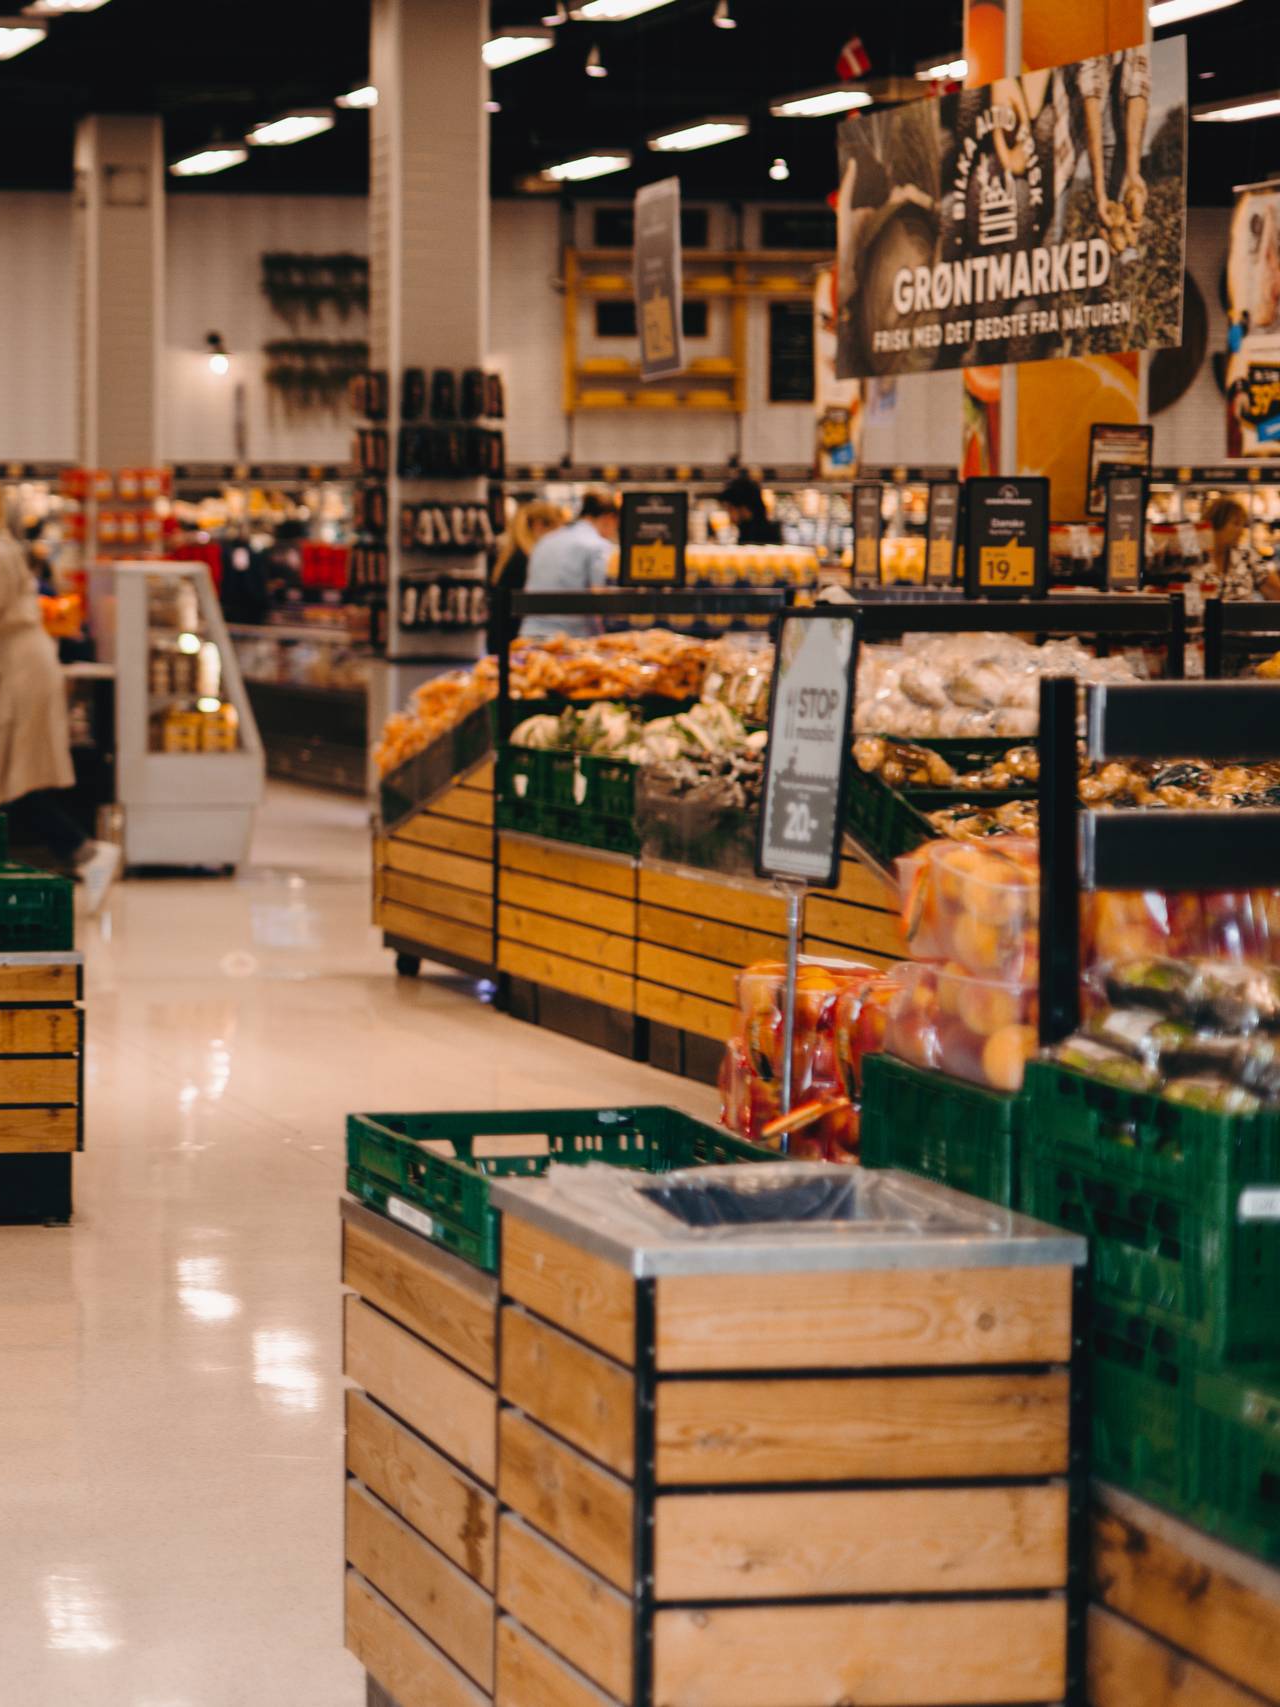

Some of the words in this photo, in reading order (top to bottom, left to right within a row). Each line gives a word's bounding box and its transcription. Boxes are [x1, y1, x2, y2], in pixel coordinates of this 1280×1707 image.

[893, 238, 1111, 314] GRØNTMARKED
[874, 327, 911, 351] FRISK
[911, 322, 943, 348] MED
[945, 320, 972, 345] DET
[975, 312, 1028, 341] BEDSTE
[1030, 309, 1059, 333] FRA
[1062, 301, 1133, 330] NATUREN
[798, 687, 839, 721] STOP
